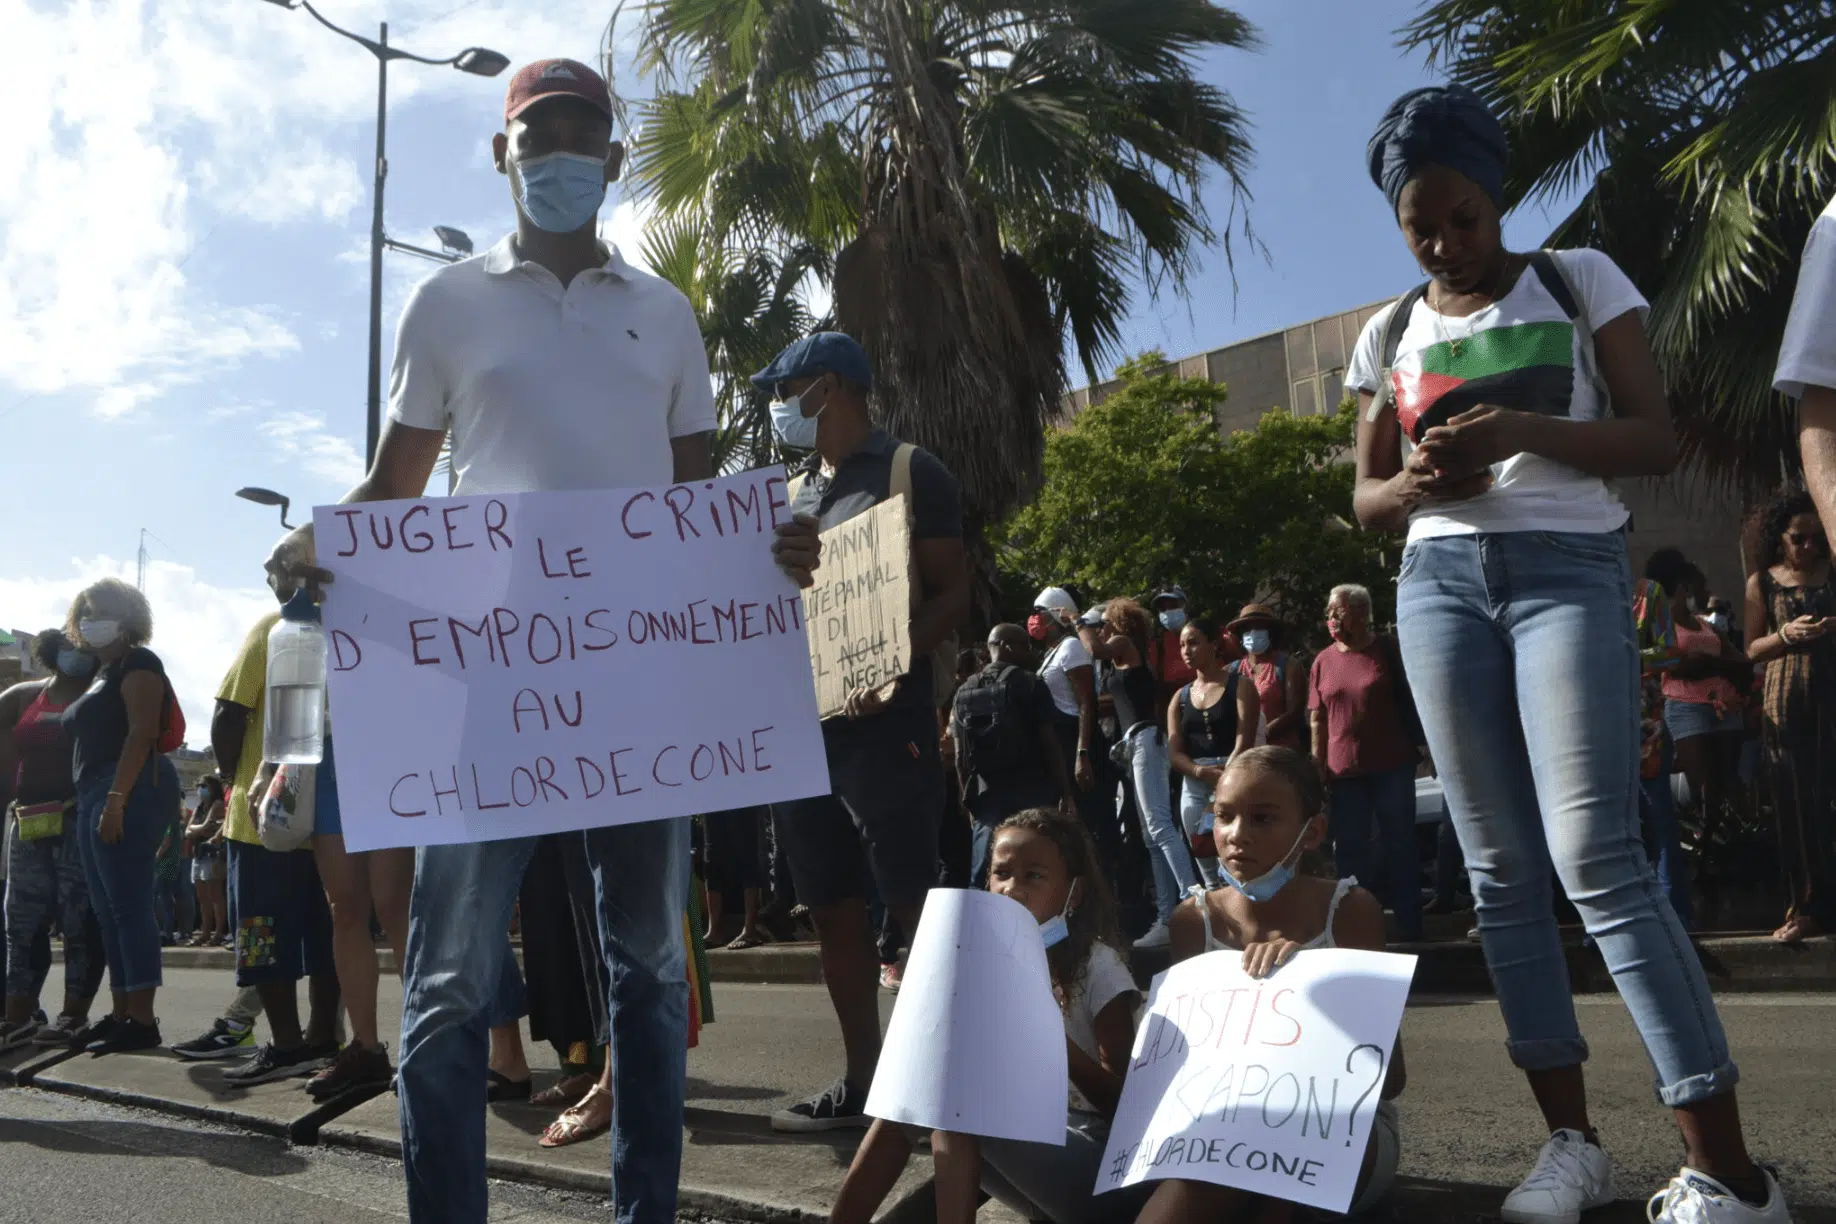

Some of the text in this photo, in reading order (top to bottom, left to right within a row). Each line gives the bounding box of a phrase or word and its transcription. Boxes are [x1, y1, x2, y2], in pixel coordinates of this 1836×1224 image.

[334, 476, 788, 579] JUGER LE CRIME
[408, 596, 801, 669] EMPOISONNEMENT
[512, 688, 582, 733] AU
[388, 726, 775, 817] CHLORDECONE
[1109, 1136, 1325, 1187] #CHLORDECONE
